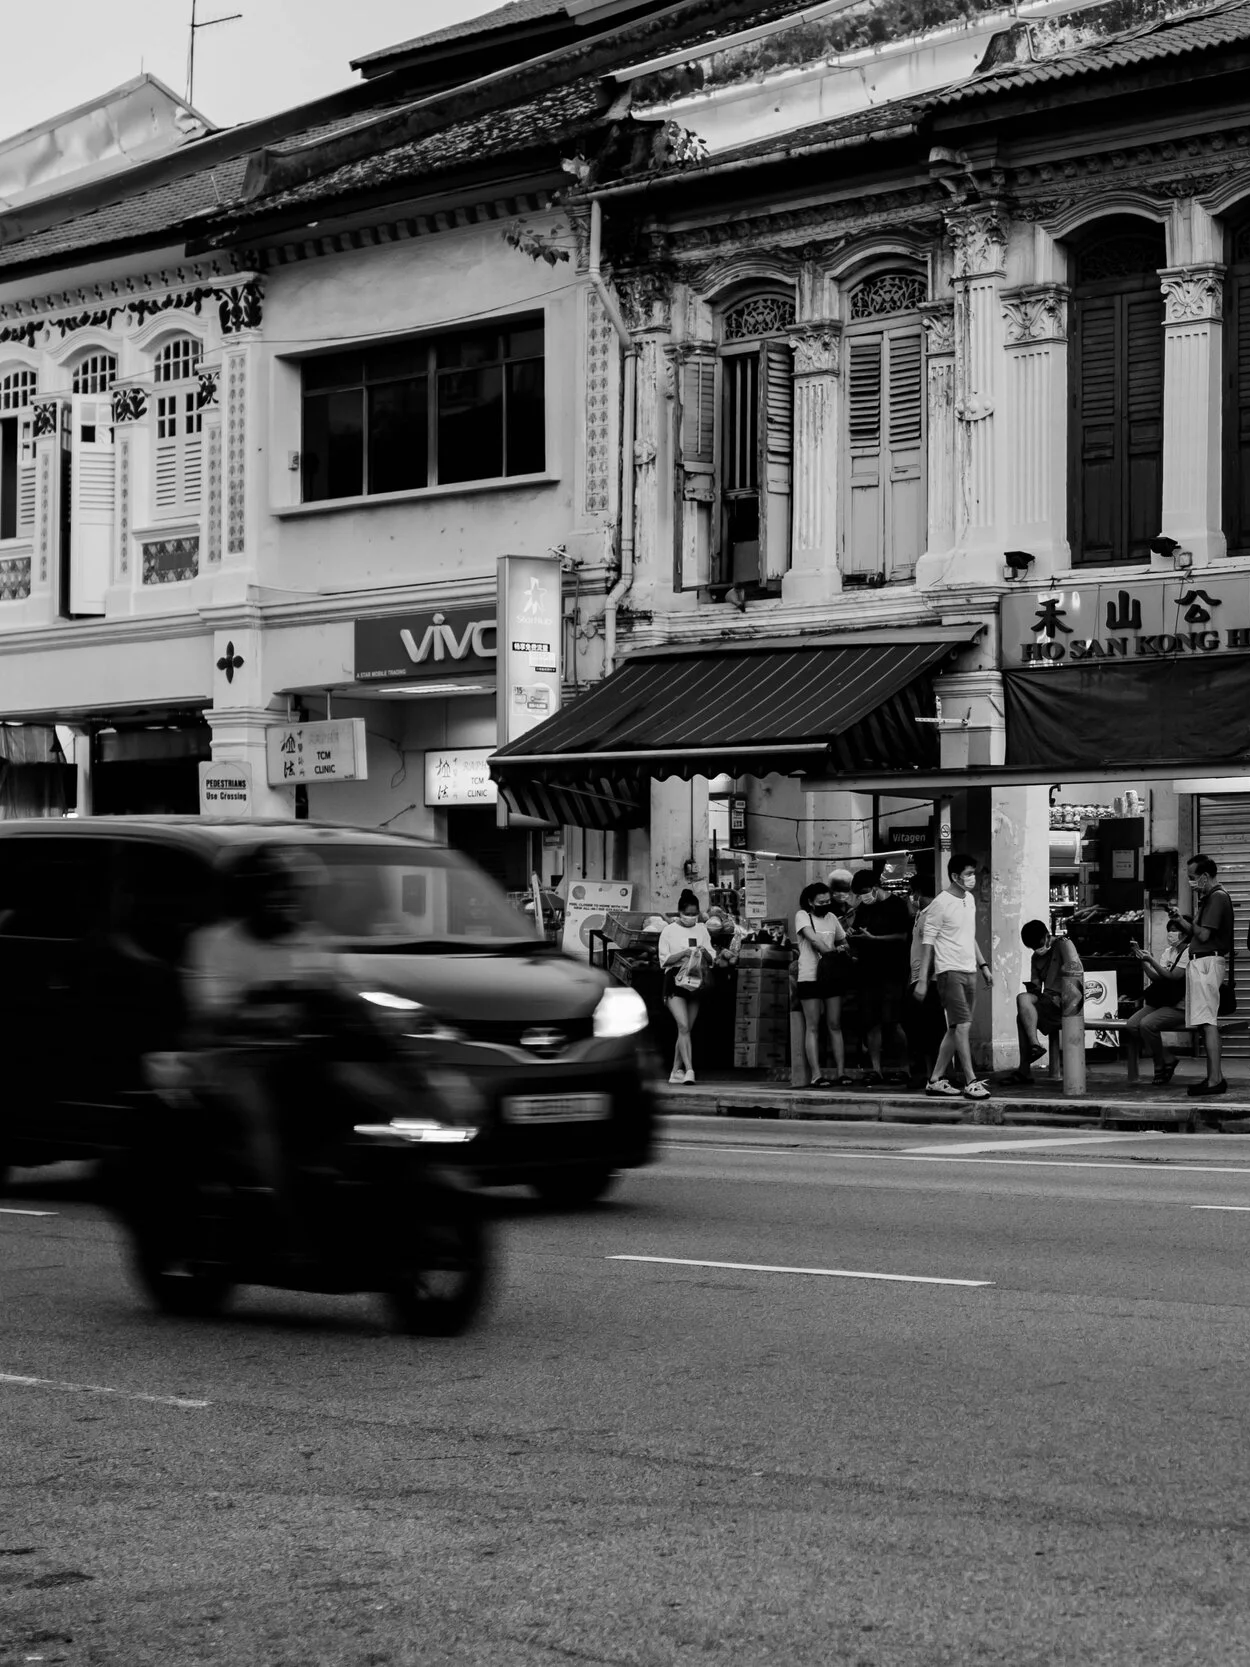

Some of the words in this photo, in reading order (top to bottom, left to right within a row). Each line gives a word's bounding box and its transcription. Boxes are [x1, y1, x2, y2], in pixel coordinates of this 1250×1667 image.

[1019, 641, 1066, 663] HO
[1068, 637, 1129, 660] SAN
[1134, 629, 1221, 656] KONG
[316, 751, 331, 761] TCM
[314, 765, 336, 775] CLINIC
[205, 779, 247, 788] PEDESTRIANS
[471, 776, 485, 785] TCM
[206, 791, 218, 800] Use
[220, 791, 247, 801] Crossing
[467, 789, 488, 798] CLINIC
[892, 832, 927, 845] Vitagen
